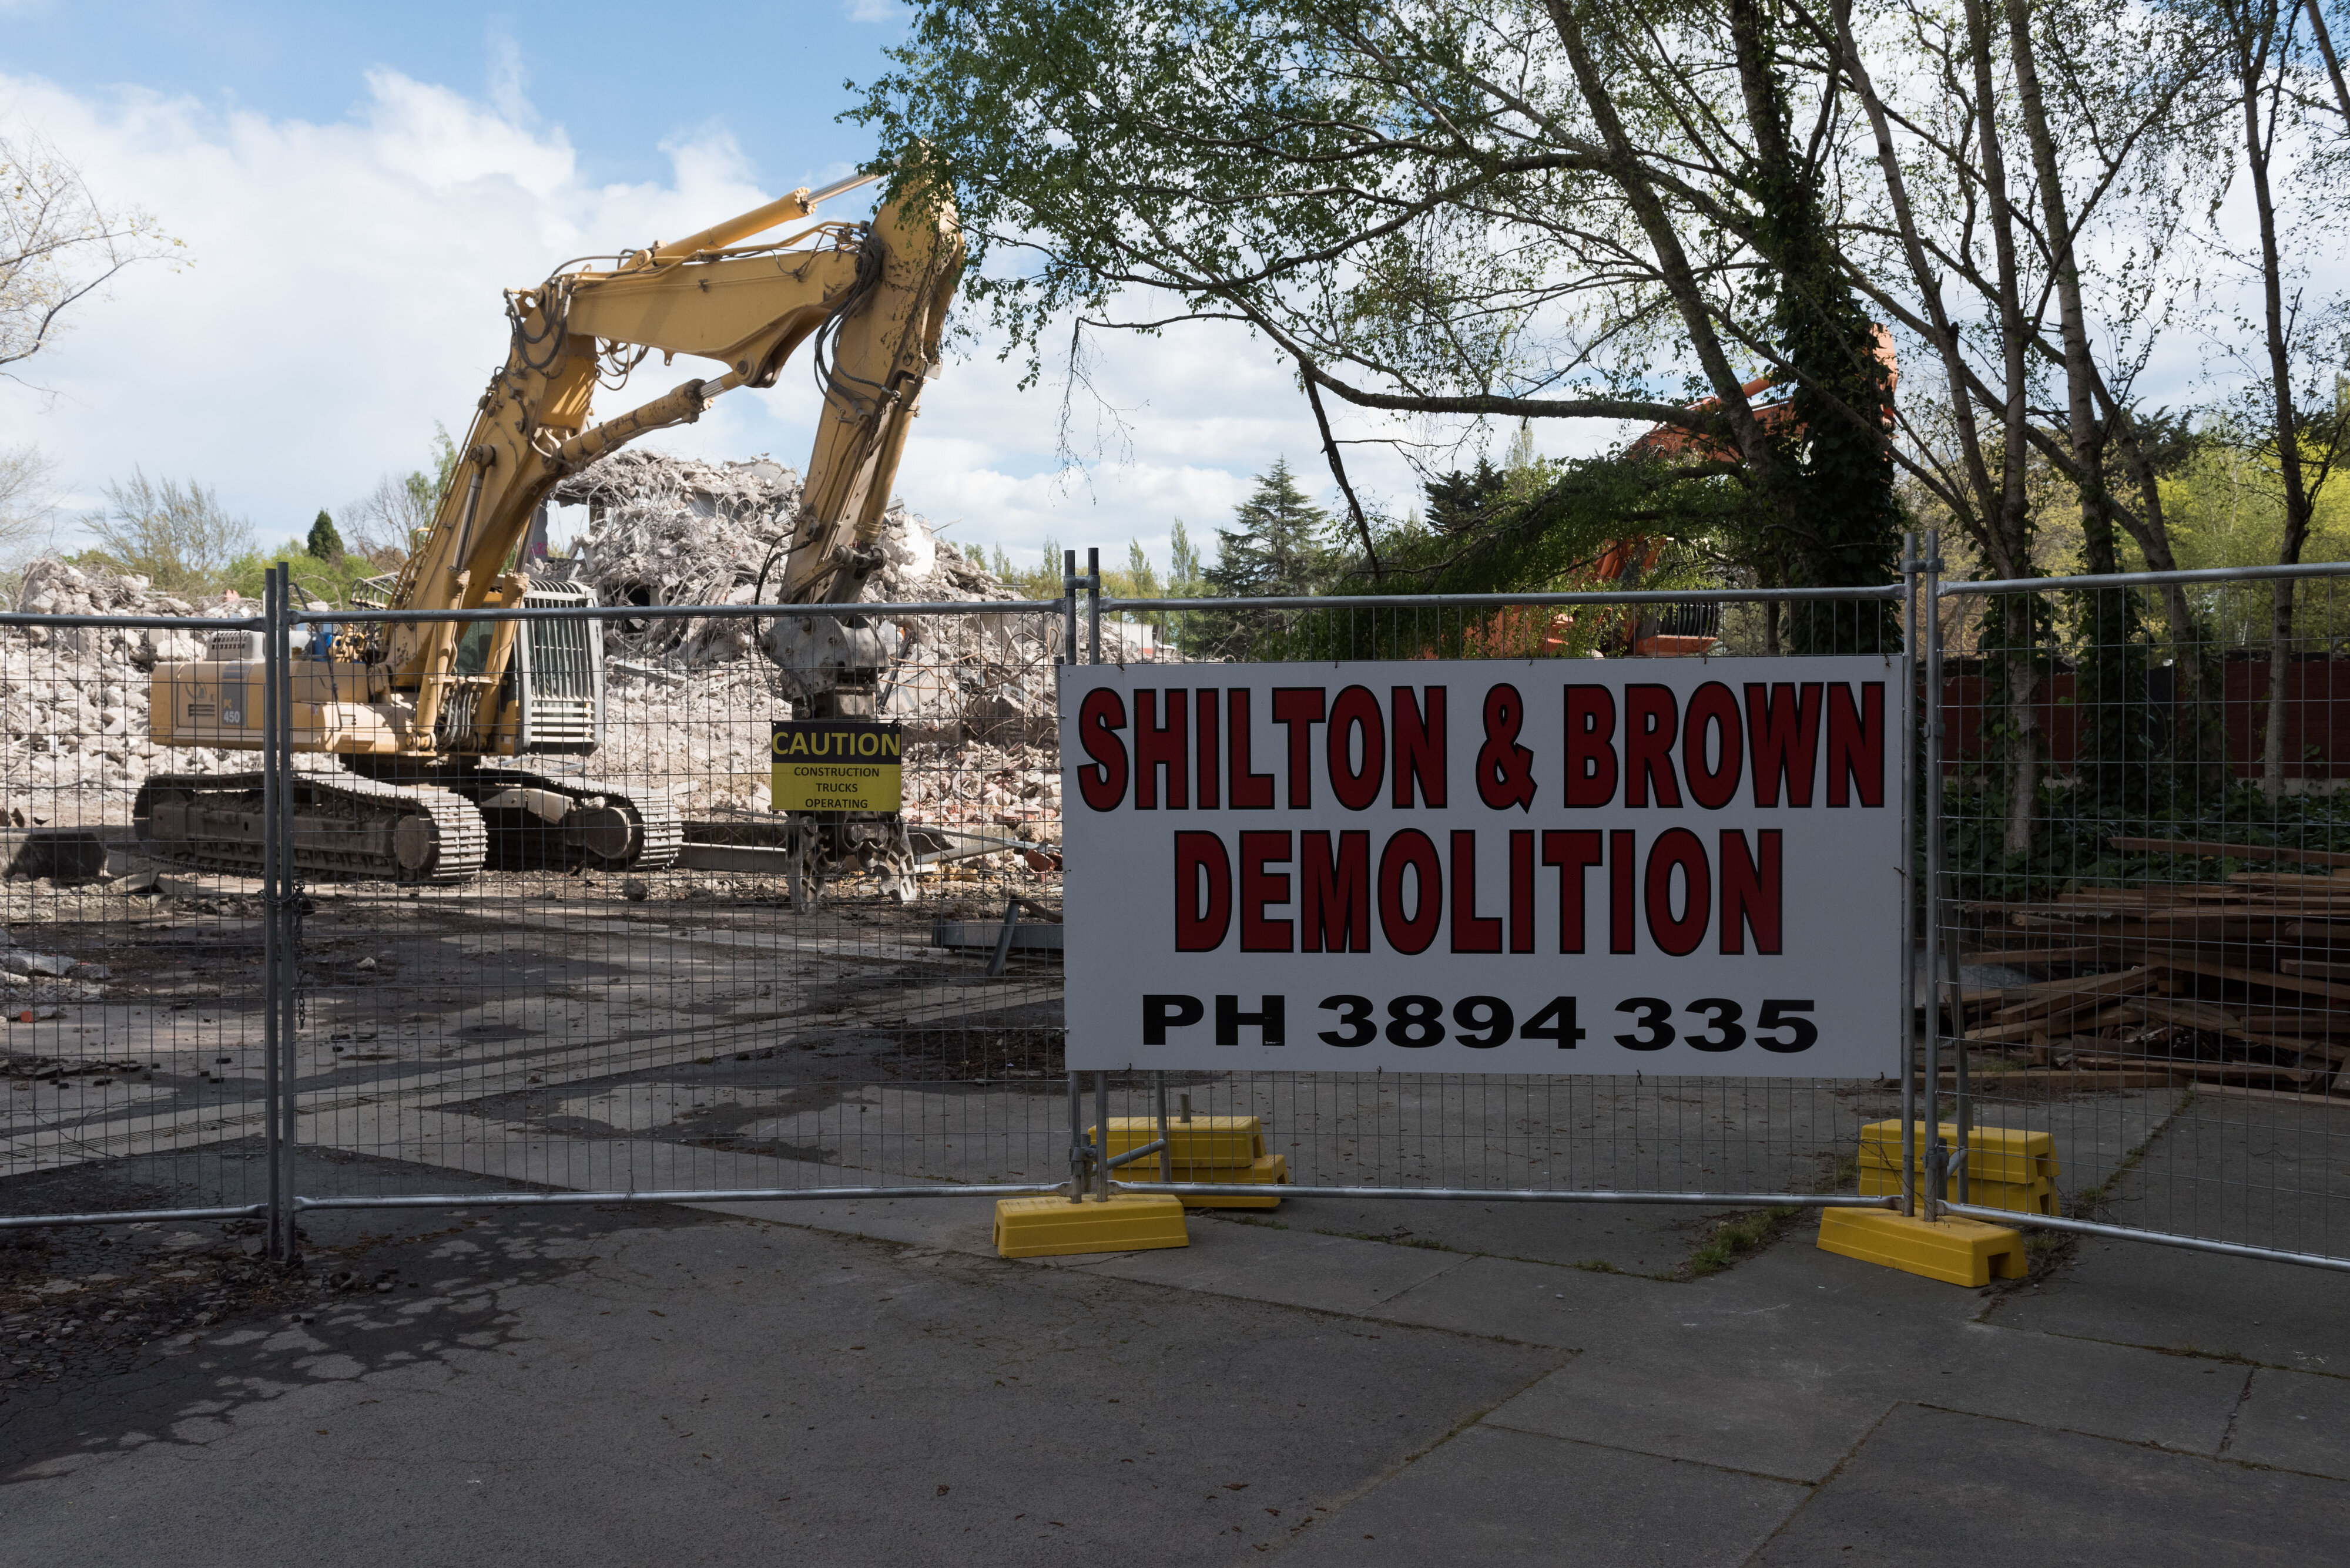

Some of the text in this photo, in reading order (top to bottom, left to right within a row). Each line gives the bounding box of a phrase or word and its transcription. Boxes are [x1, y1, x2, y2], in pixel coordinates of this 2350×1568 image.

[224, 711, 240, 723] 450
[772, 732, 900, 756] CAUTION
[1077, 681, 1885, 814] SHILTON & BROWN
[794, 767, 879, 777] CONSTRUCTION
[816, 783, 857, 792] TRUCKS
[805, 798, 867, 808] OPERATING
[1174, 827, 1782, 956] DEMOLITION
[1143, 995, 1818, 1053] PH 3894 335
